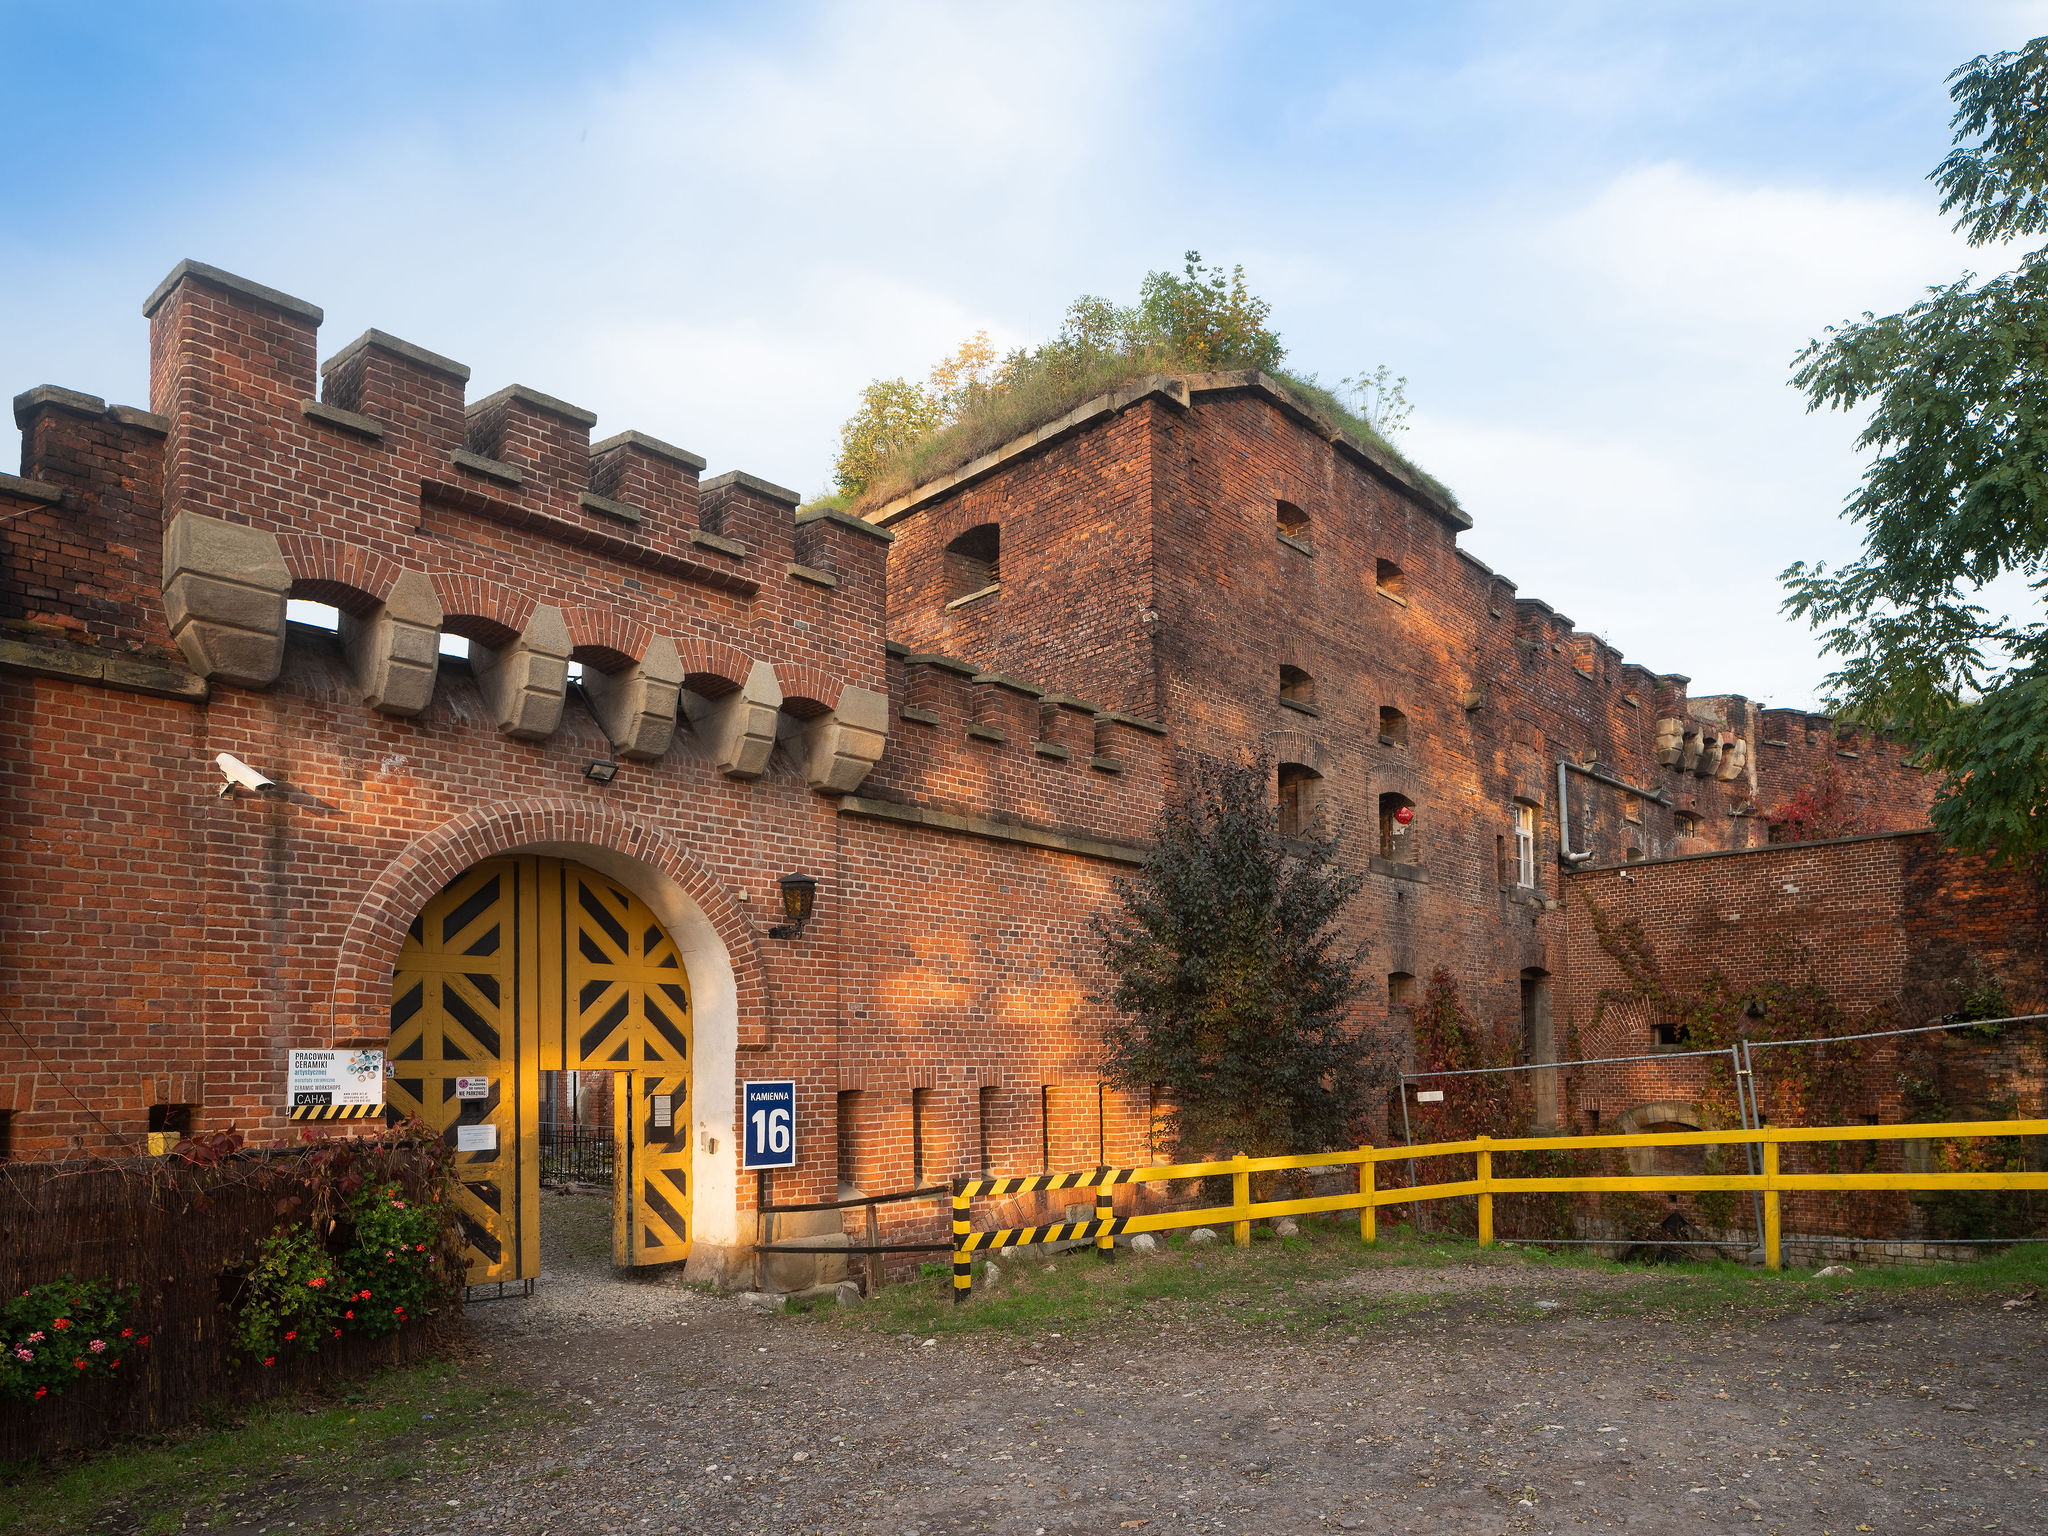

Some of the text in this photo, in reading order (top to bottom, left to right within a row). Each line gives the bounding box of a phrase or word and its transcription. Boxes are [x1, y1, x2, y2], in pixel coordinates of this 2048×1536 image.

[295, 1052, 335, 1060] PRACOWNIA
[297, 1094, 326, 1105] CAHA
[750, 1092, 789, 1101] KAMIENNA
[752, 1108, 790, 1153] 16
